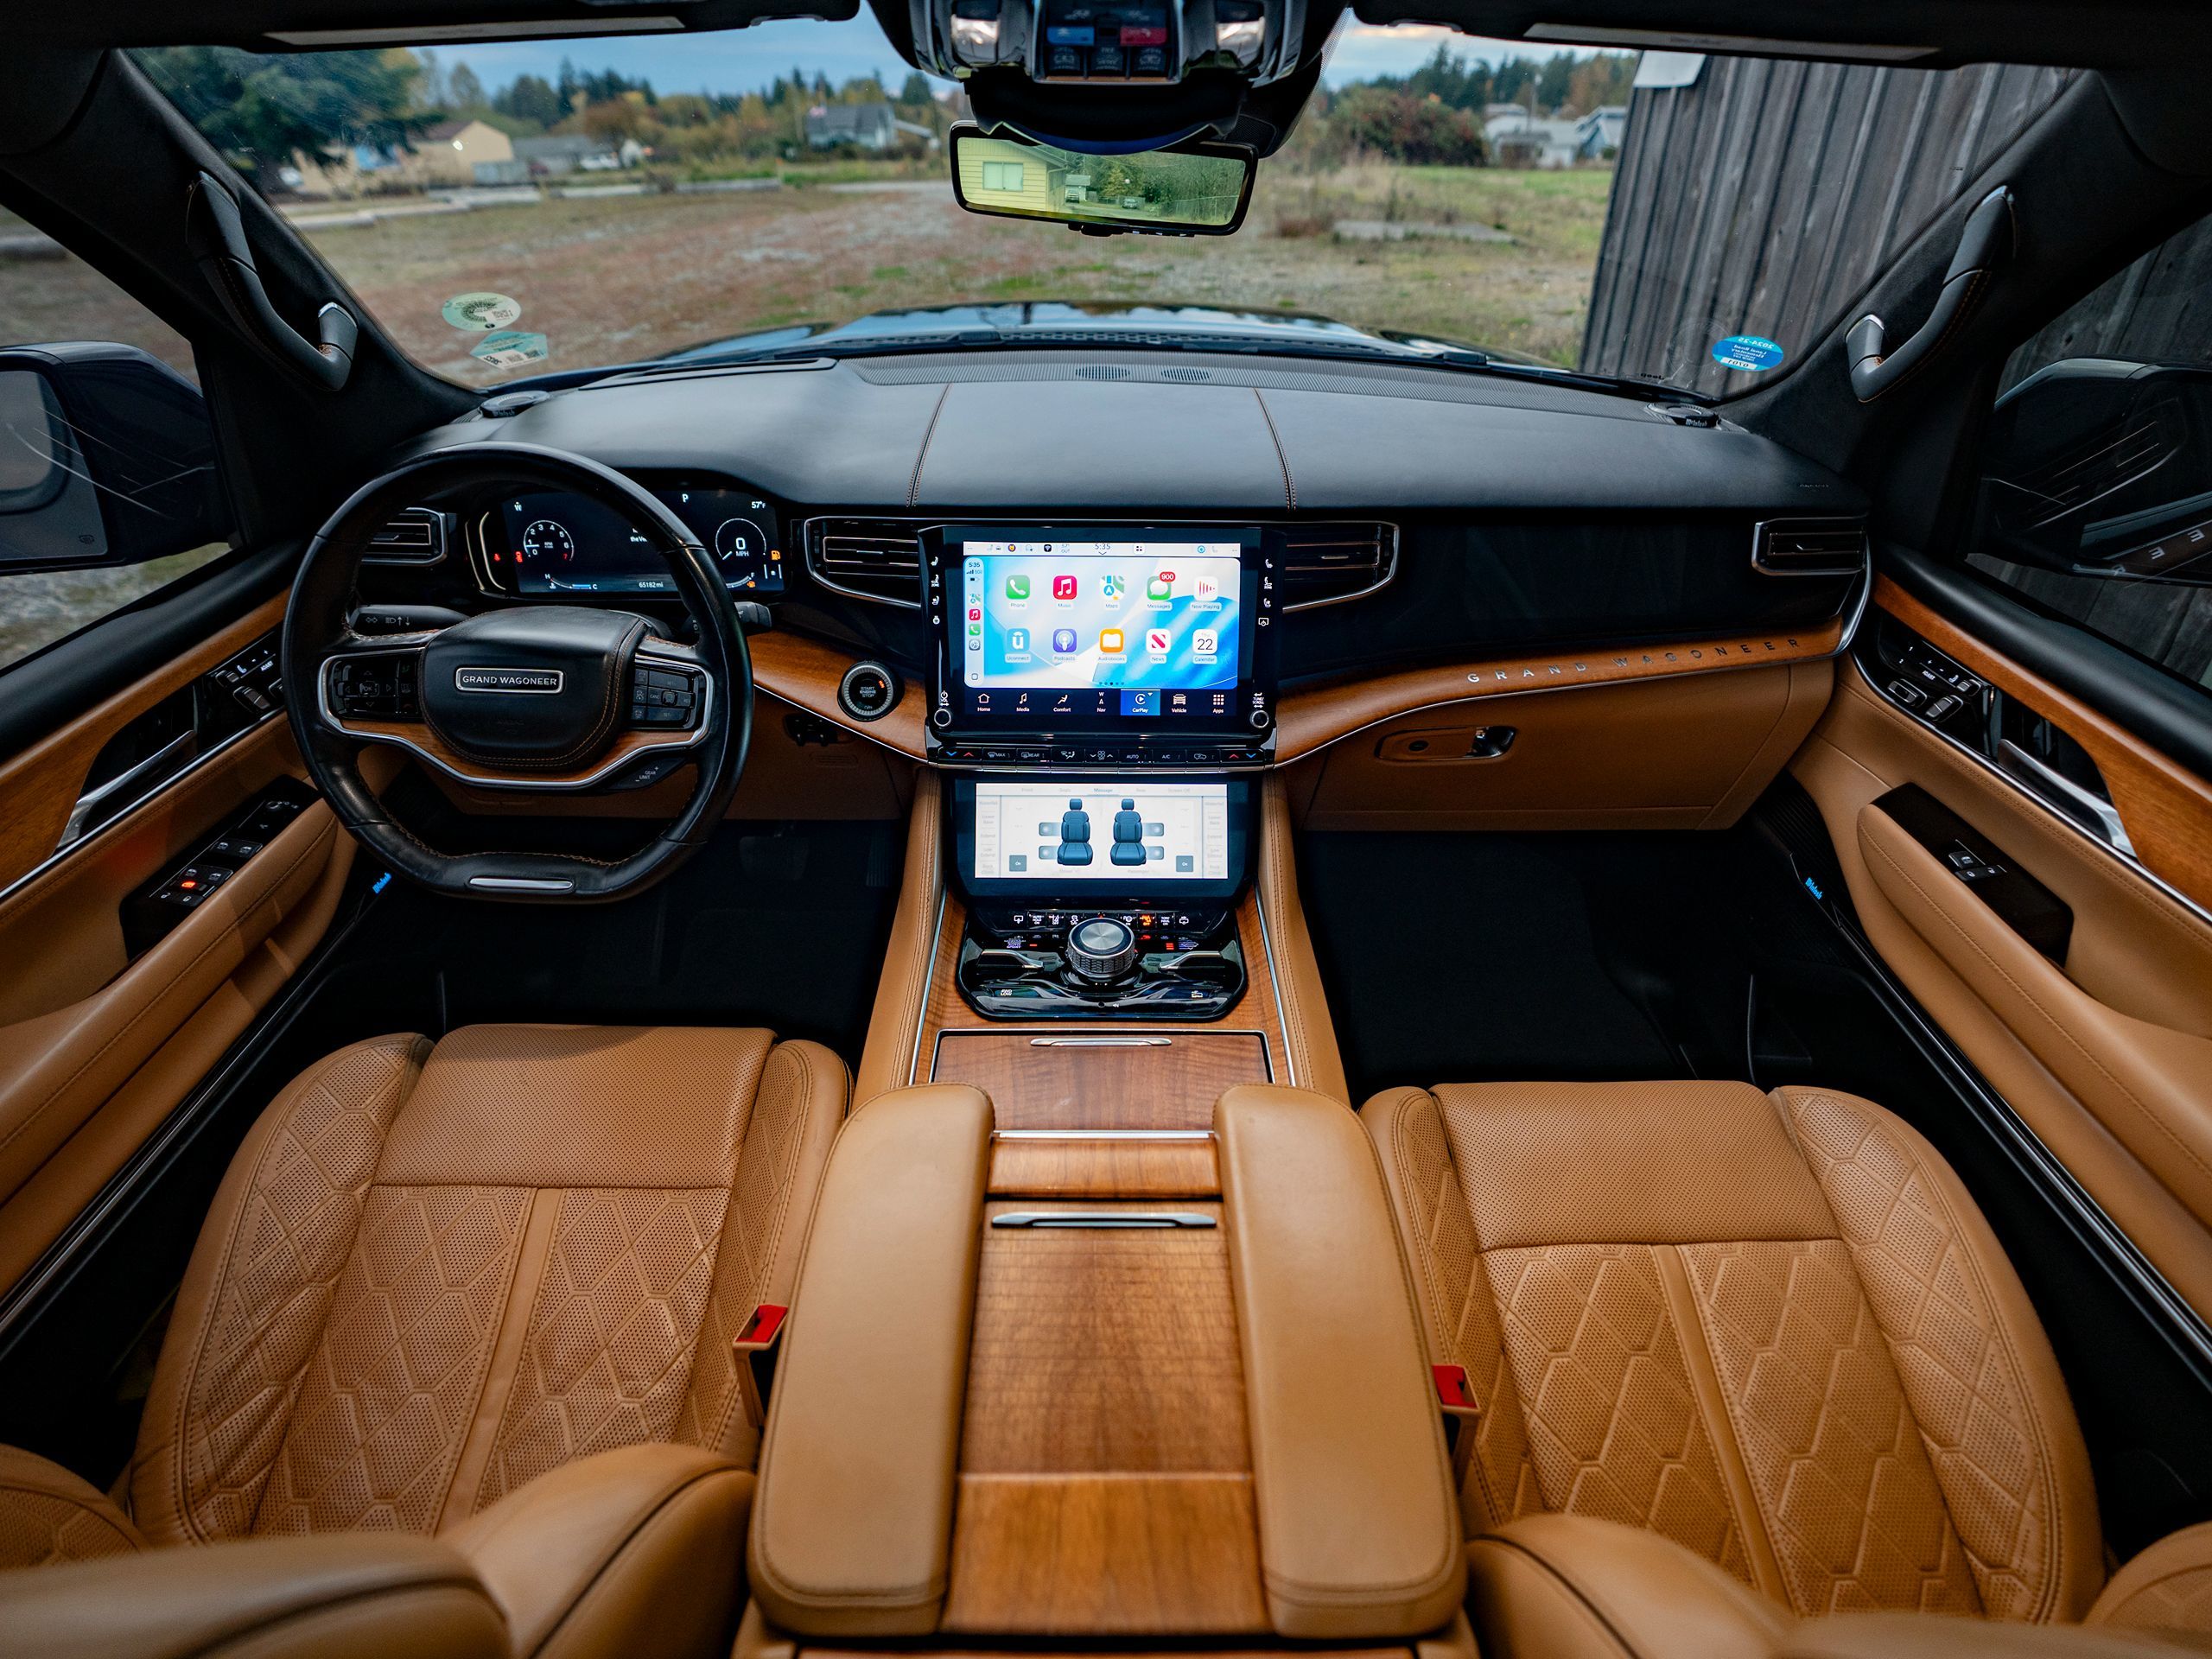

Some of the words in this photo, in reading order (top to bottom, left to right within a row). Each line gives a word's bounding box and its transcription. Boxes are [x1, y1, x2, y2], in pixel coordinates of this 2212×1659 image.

[682, 493, 690, 503] P
[735, 537, 746, 550] 0
[1197, 639, 1213, 651] 22
[1467, 662, 1586, 683] GRAND
[1611, 639, 1800, 668] WAGONEER
[462, 675, 498, 683] GRAND
[499, 677, 557, 686] WAGONEER
